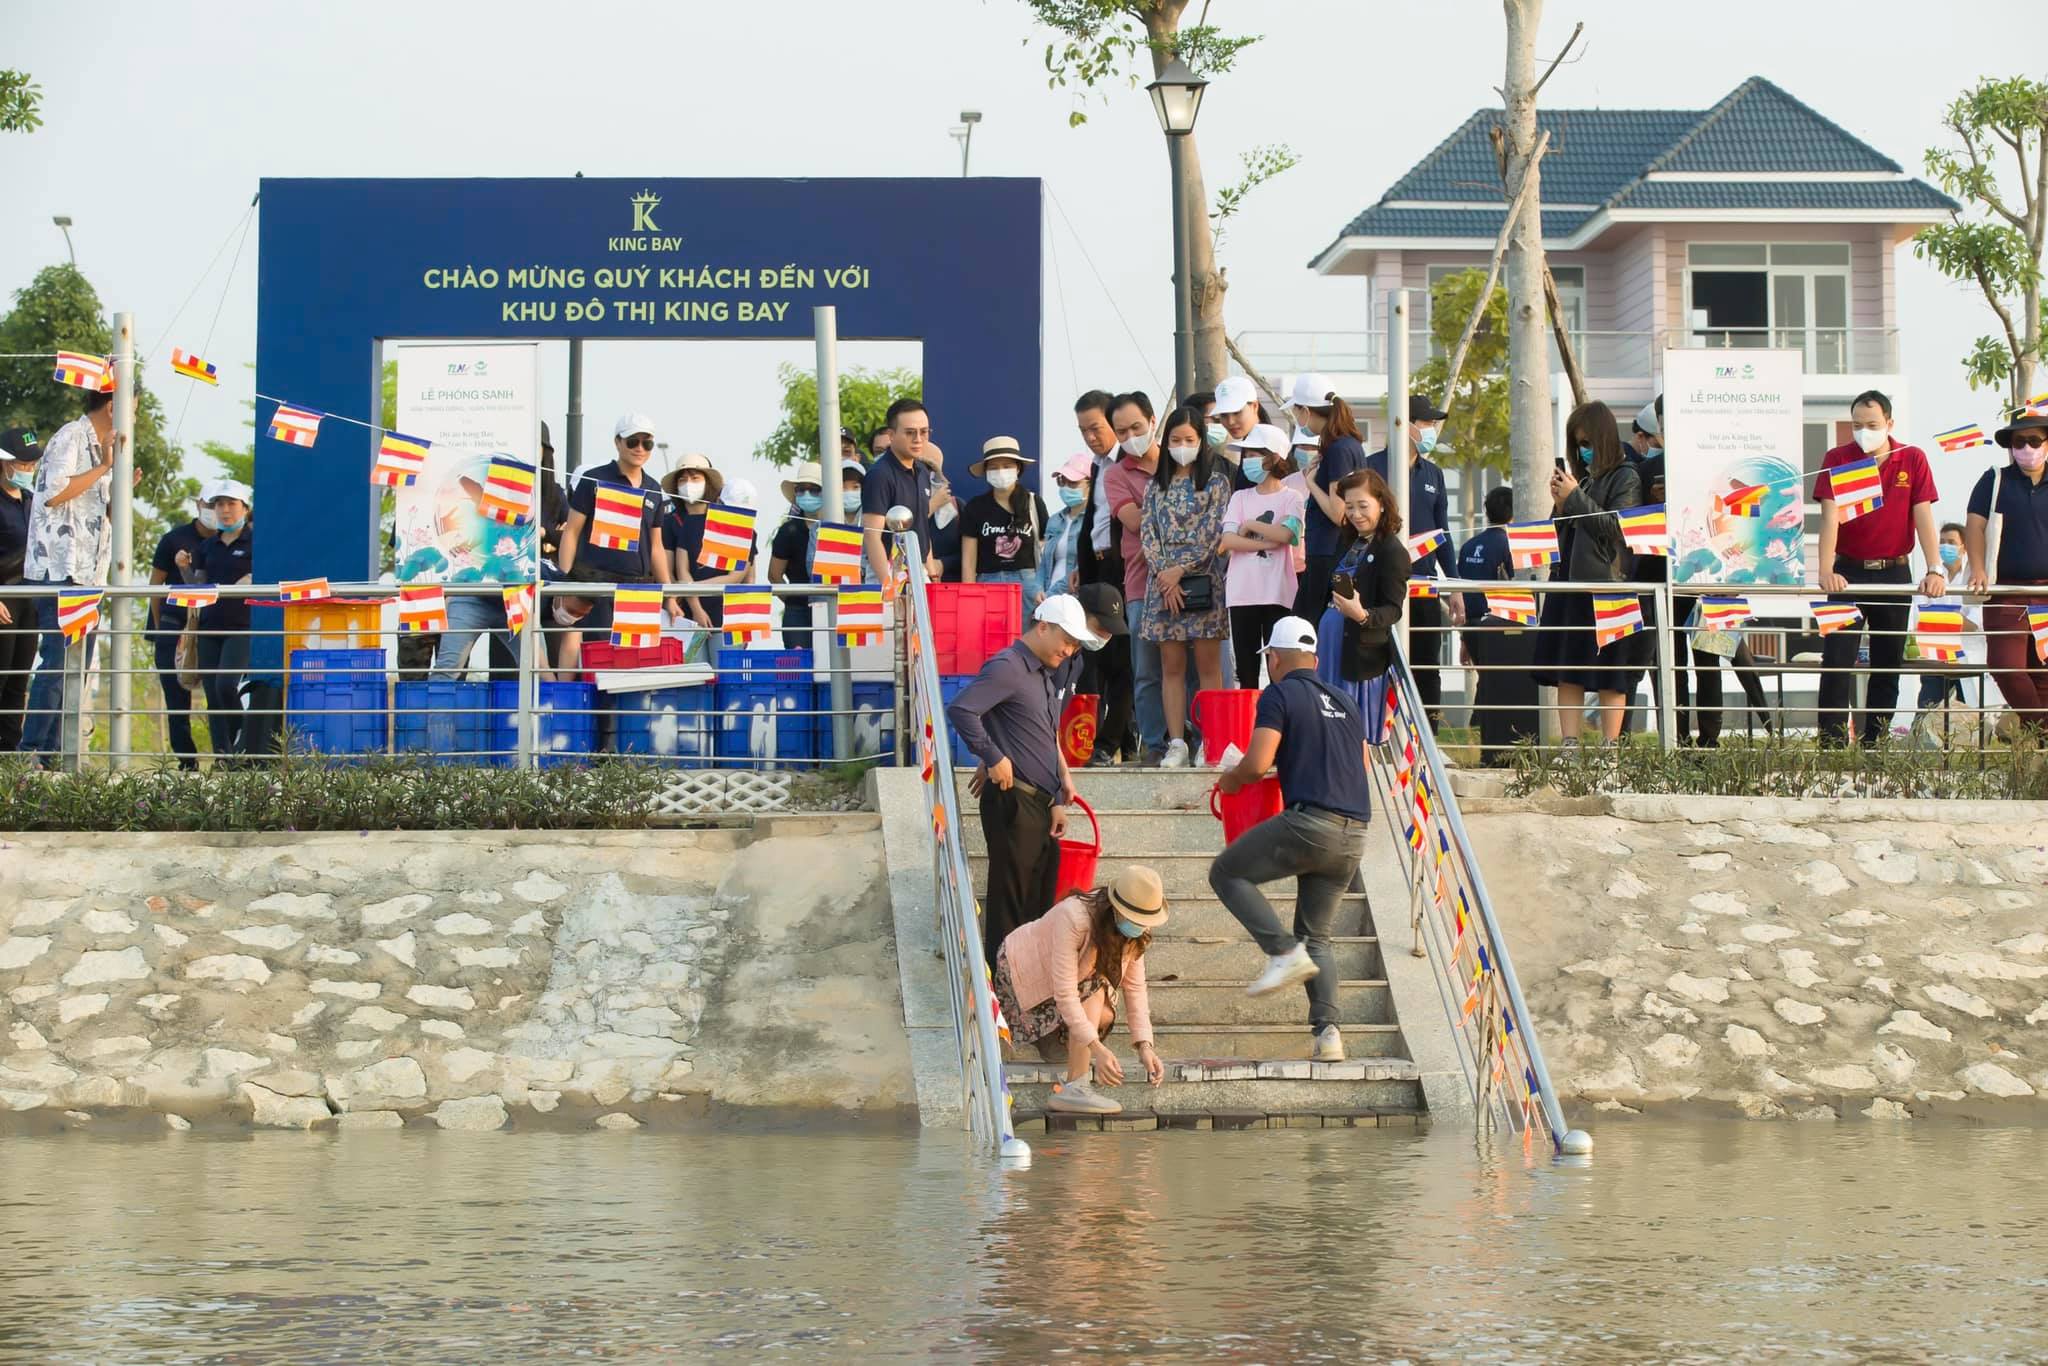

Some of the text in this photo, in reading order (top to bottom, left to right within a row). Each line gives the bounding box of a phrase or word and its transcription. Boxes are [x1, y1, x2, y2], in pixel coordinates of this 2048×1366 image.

[631, 202, 662, 231] K
[608, 237, 683, 251] KING BAY
[423, 263, 870, 289] CHÀO MỪNG QUÝ KHÁCH ĐẾN VỚI
[502, 297, 790, 325] KHU ĐÔ THỊ KING BAY
[438, 389, 479, 400] PHÓNG
[482, 389, 514, 400] SANH
[1707, 392, 1747, 403] PHÓNG
[1750, 393, 1781, 403] SANH
